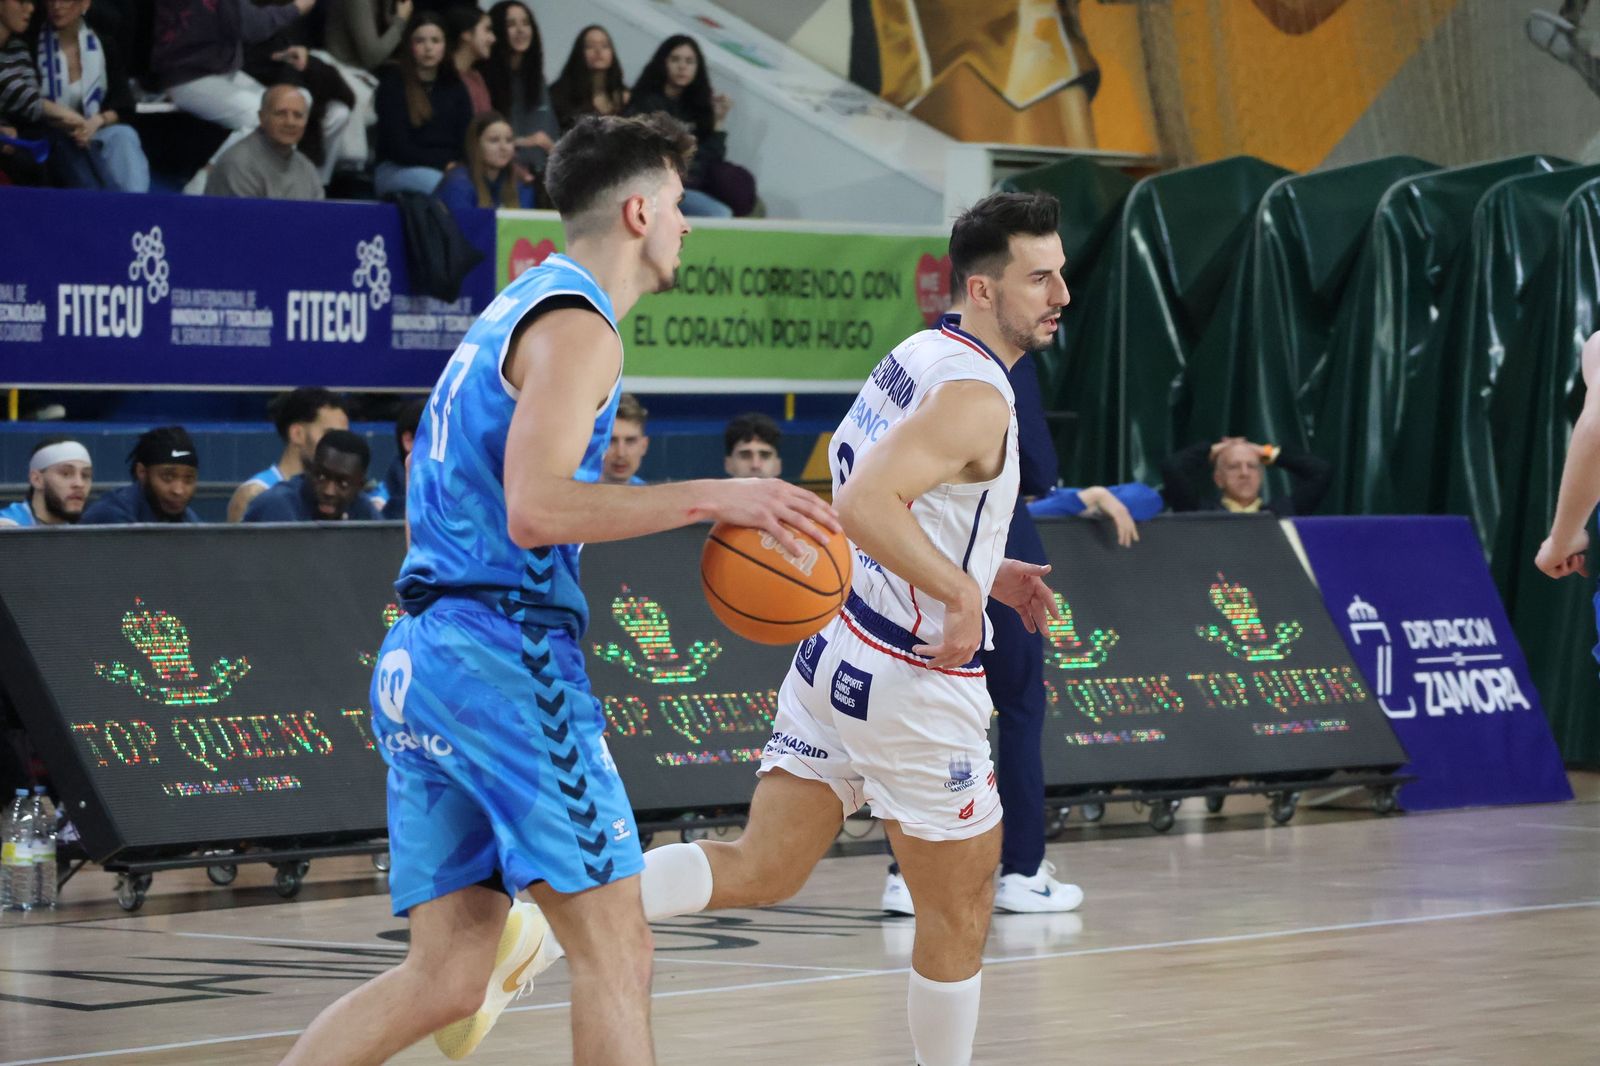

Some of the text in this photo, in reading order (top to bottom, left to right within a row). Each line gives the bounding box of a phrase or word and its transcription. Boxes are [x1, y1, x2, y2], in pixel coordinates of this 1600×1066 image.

[673, 258, 734, 296] ACIÓN
[862, 271, 902, 299] CON
[57, 283, 143, 339] FITECU
[287, 291, 367, 342] FITECU
[634, 309, 873, 349] EL CORAZÓN POR HUGO
[841, 672, 864, 691] DEPORTE
[1065, 673, 1184, 724] QUEENS
[1186, 665, 1367, 714] TOP QUEENS
[1413, 666, 1532, 717] ZAMORA
[70, 719, 160, 767] TOP
[171, 710, 334, 772] QUEENS
[603, 695, 652, 737] OP
